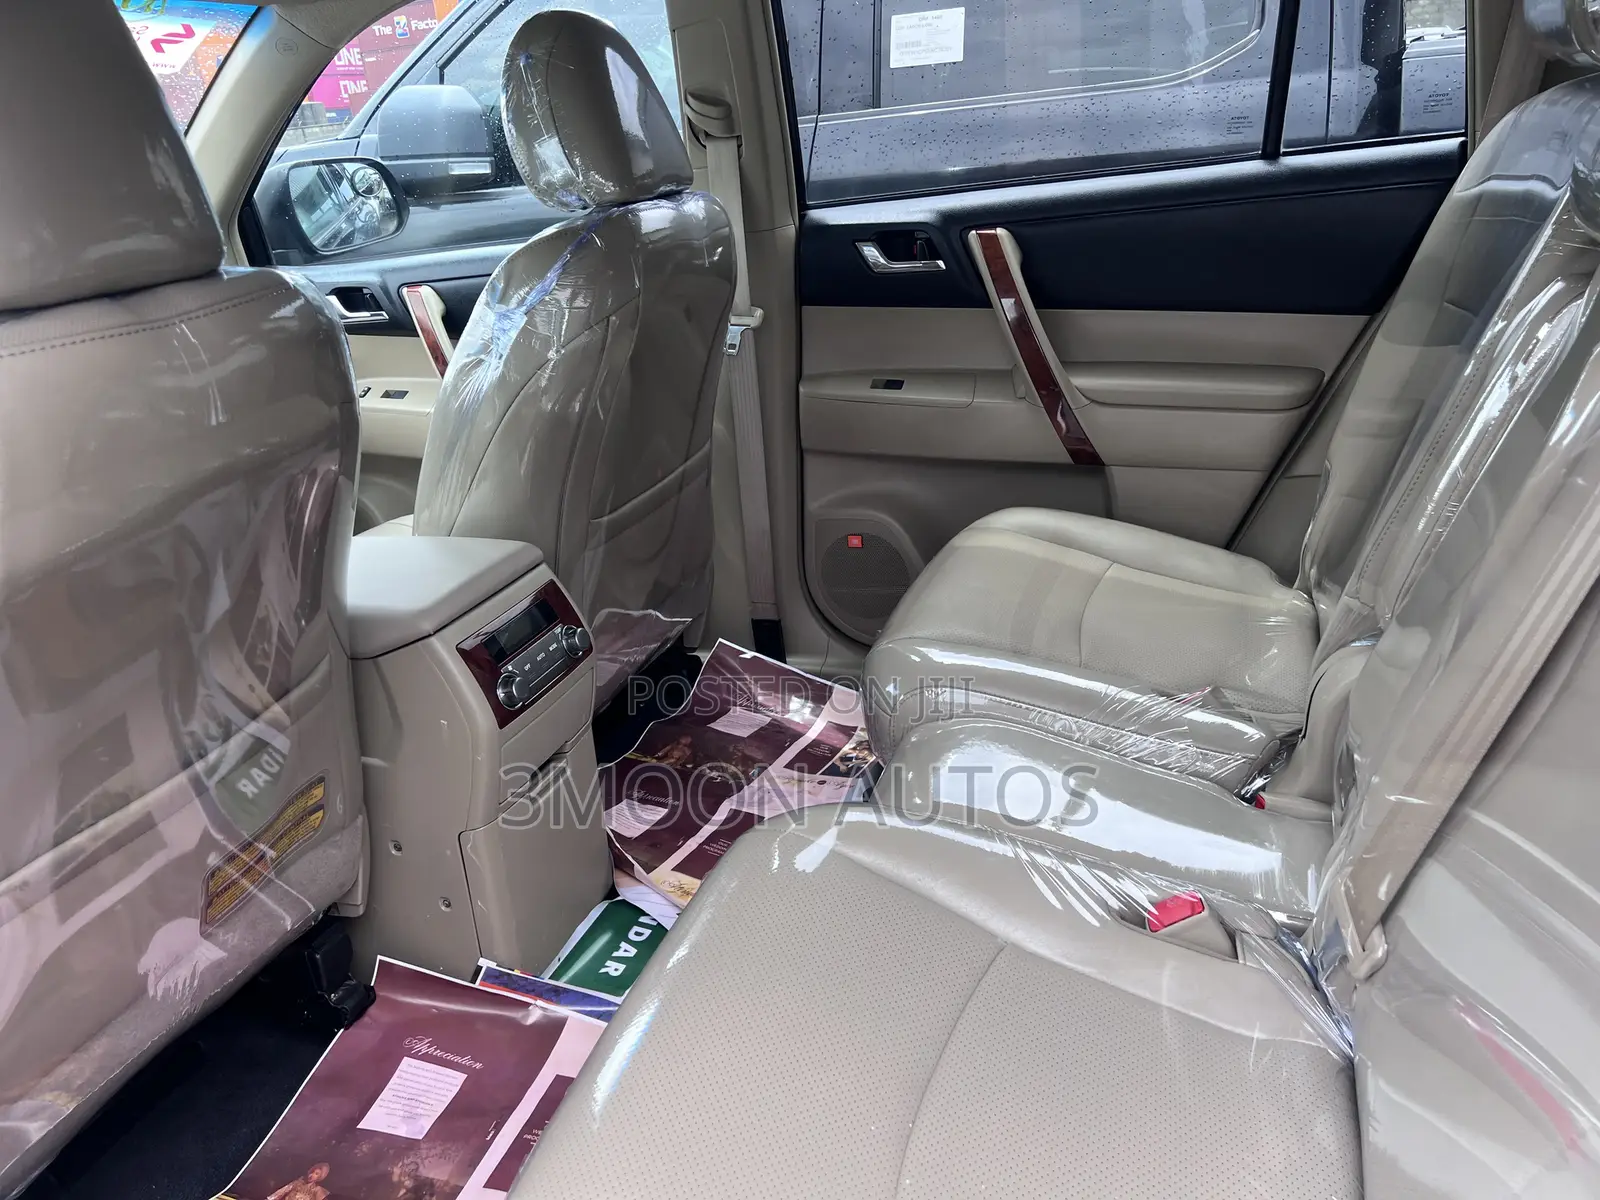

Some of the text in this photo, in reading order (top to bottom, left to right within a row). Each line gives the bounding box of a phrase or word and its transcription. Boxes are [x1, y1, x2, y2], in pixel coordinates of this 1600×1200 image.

[372, 25, 393, 36] The
[536, 652, 546, 661] AUTO
[403, 1035, 484, 1069] Appreciation
